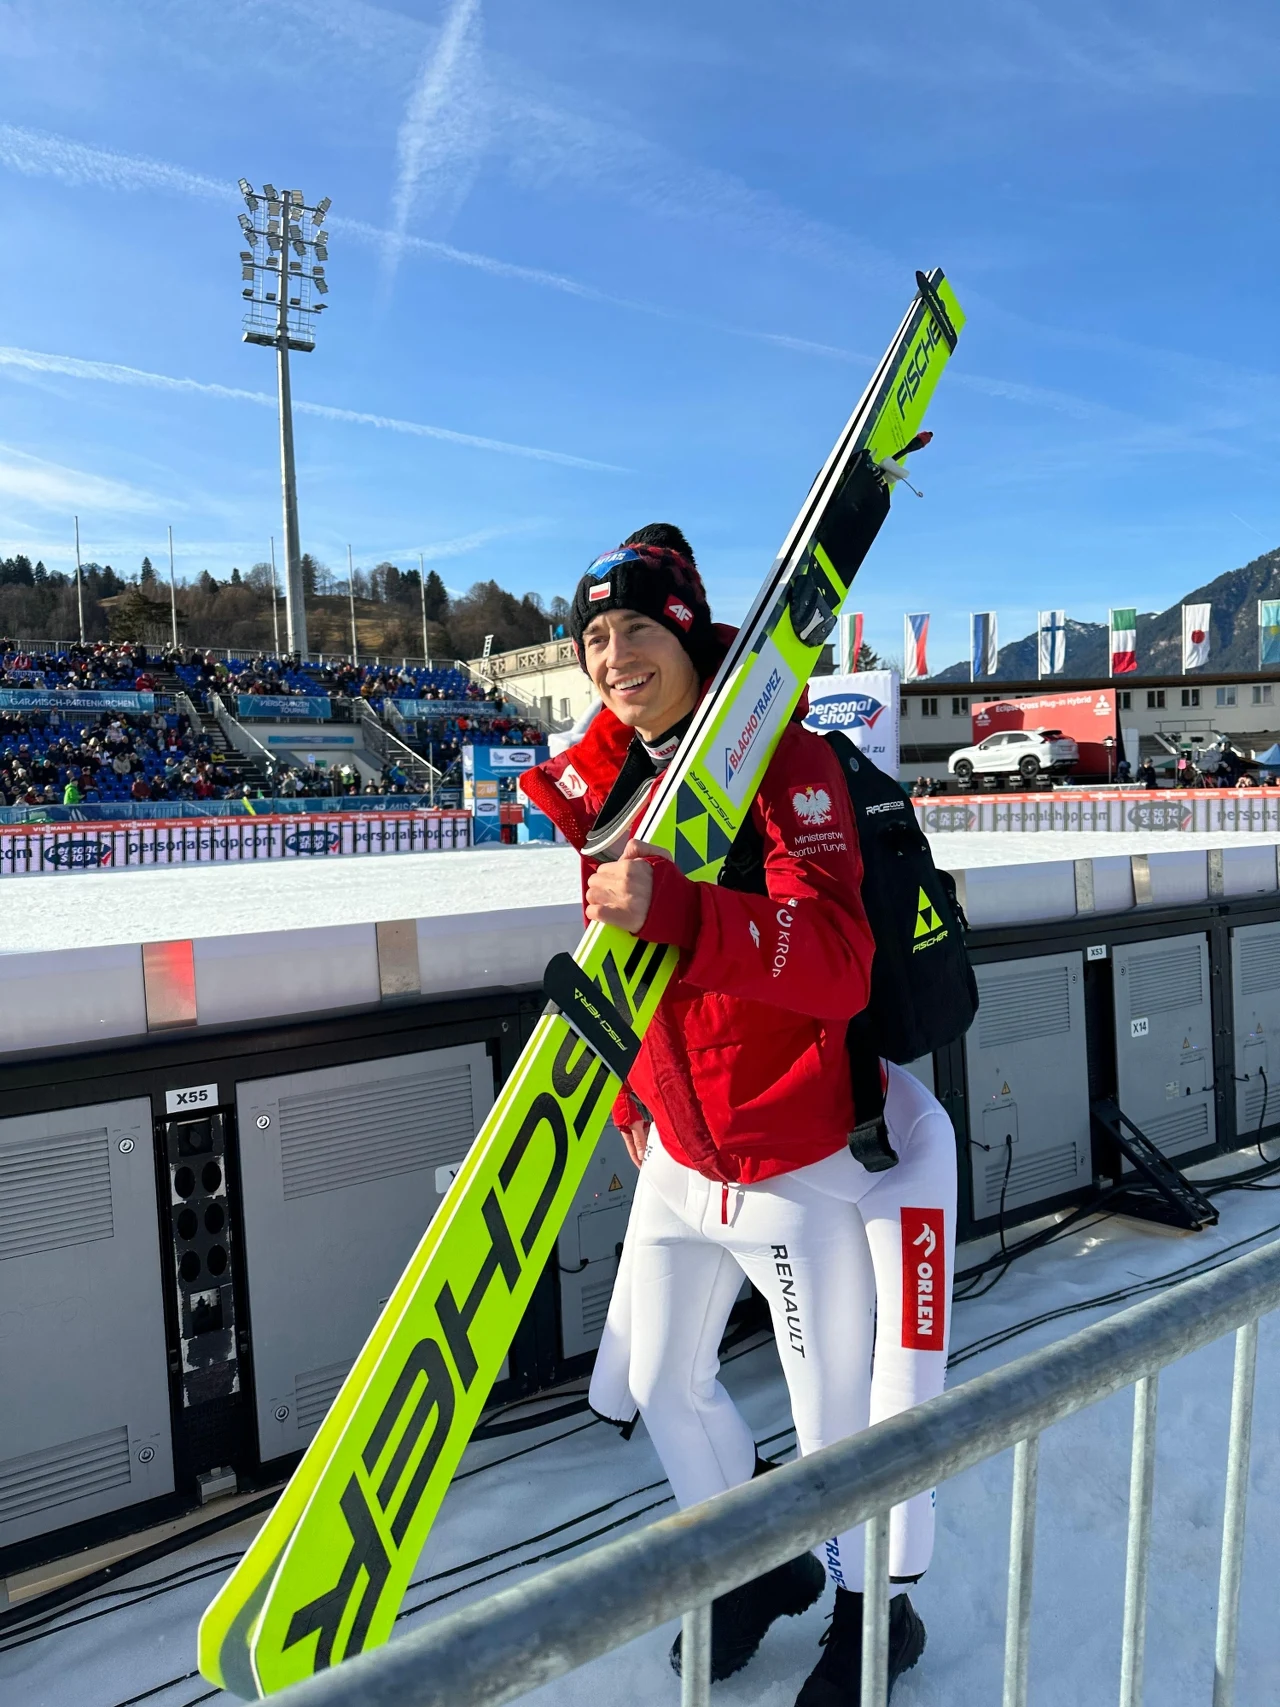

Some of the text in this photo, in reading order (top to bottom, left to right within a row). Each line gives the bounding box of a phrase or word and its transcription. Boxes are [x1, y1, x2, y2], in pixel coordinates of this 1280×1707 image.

[896, 316, 943, 422] FISCHE
[806, 698, 873, 718] personal
[1020, 702, 1039, 710] Cross
[1040, 698, 1066, 709] Plug-in
[1067, 696, 1092, 706] Hybrid
[728, 667, 783, 770] BLACHOTRAPEZ
[818, 709, 855, 726] shop
[872, 746, 886, 754] zu
[688, 770, 737, 831] FISCHER
[355, 826, 470, 842] personalshop.com
[794, 831, 843, 845] Ministerstw
[822, 843, 847, 852] Turys
[912, 930, 949, 954] FISCHER
[579, 996, 629, 1052] FISCHER
[1132, 1021, 1147, 1034] X14
[176, 1089, 209, 1106] X55
[770, 1244, 806, 1358] RENAULT
[917, 1262, 933, 1336] ORLEN
